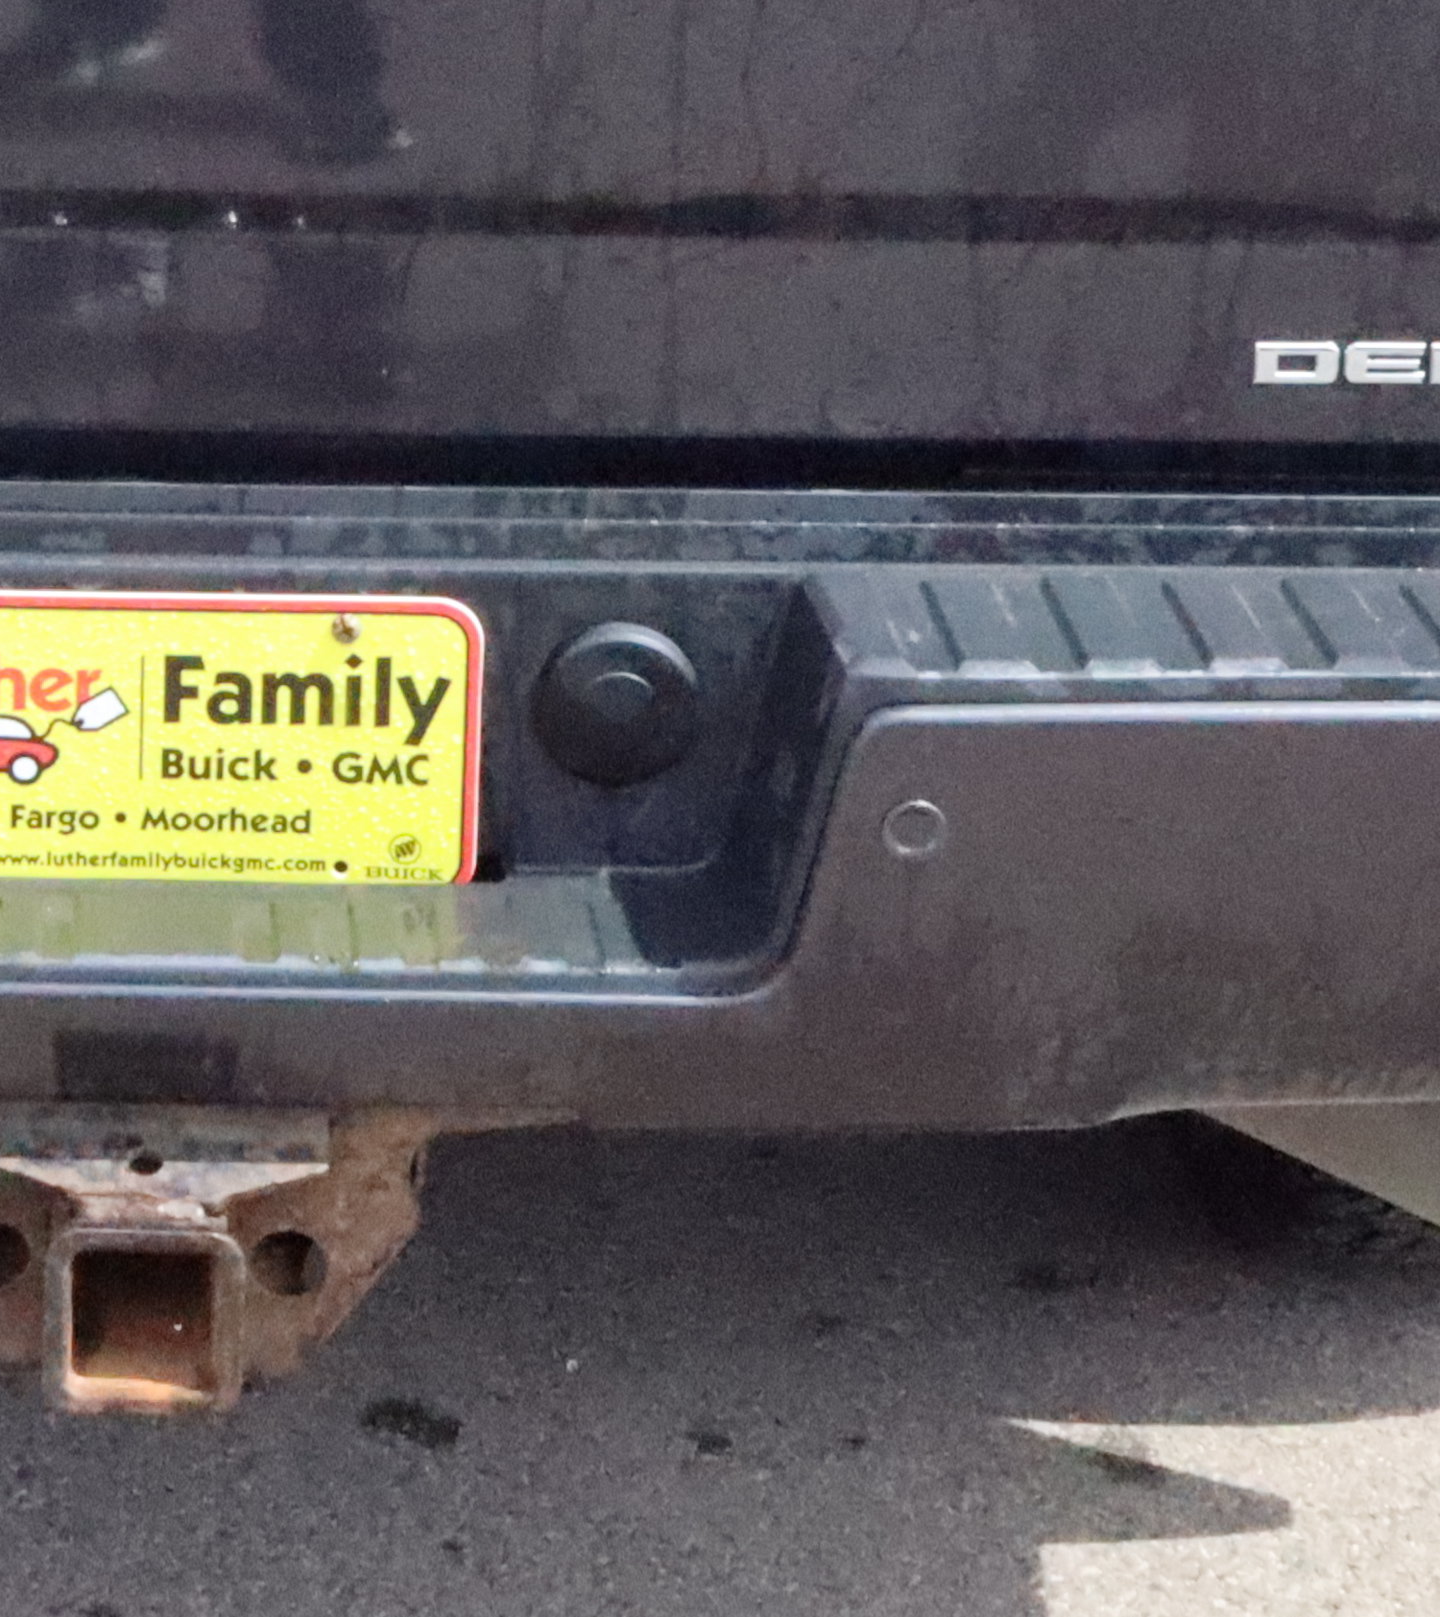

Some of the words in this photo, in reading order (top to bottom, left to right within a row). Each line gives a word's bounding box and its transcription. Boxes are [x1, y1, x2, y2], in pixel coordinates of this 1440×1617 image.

[163, 653, 452, 746] Family
[161, 748, 278, 781] Buick
[332, 751, 430, 786] GMC
[10, 804, 100, 835] Fargo
[141, 806, 312, 834] Moorhead
[363, 865, 445, 882] BUICK
